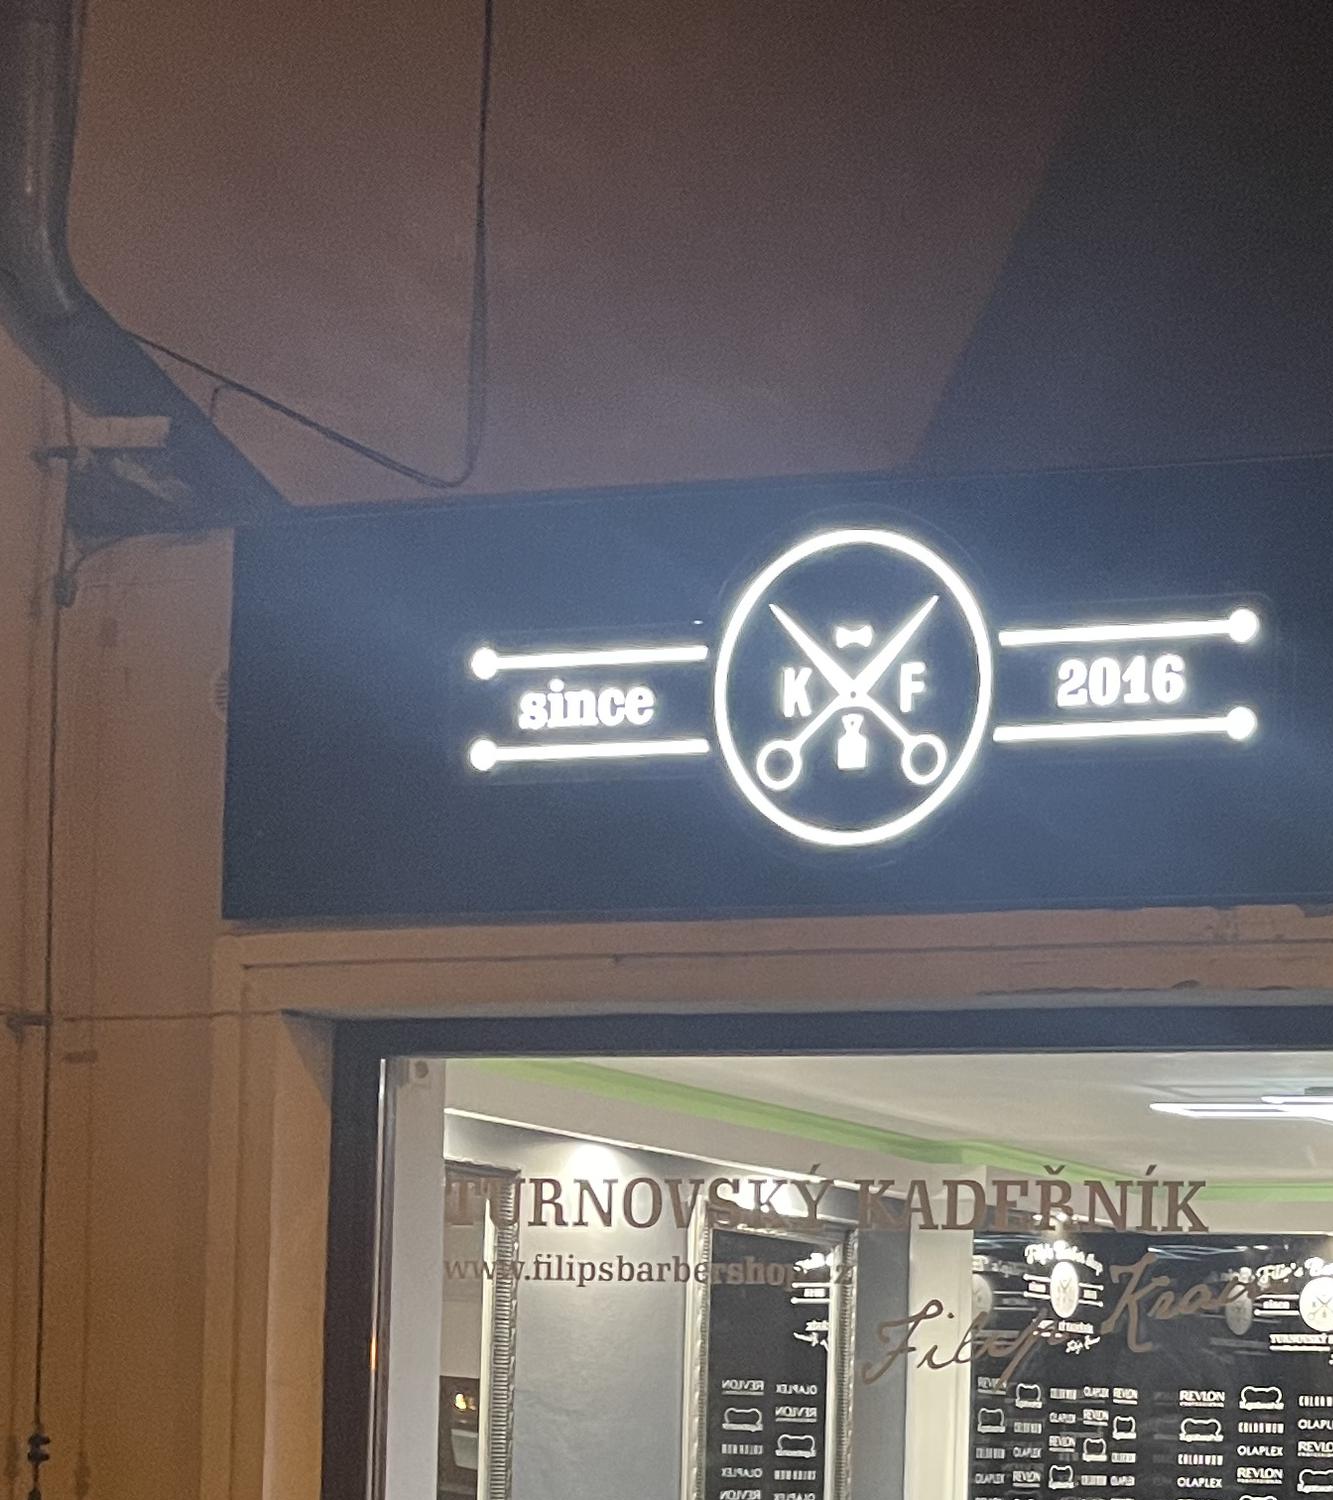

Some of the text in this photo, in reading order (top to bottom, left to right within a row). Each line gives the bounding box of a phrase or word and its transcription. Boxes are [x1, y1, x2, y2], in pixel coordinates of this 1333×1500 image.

[782, 660, 927, 718] K F
[1056, 655, 1186, 710] 2016
[518, 680, 656, 731] since
[445, 1164, 1209, 1234] TURNOVSKÝ KADEŘNÍK
[1179, 1390, 1225, 1402] REVLON
[1236, 1445, 1284, 1458] OLAPLEX
[1176, 1476, 1223, 1489] OLAPLEX
[1237, 1467, 1284, 1479] REVLON
